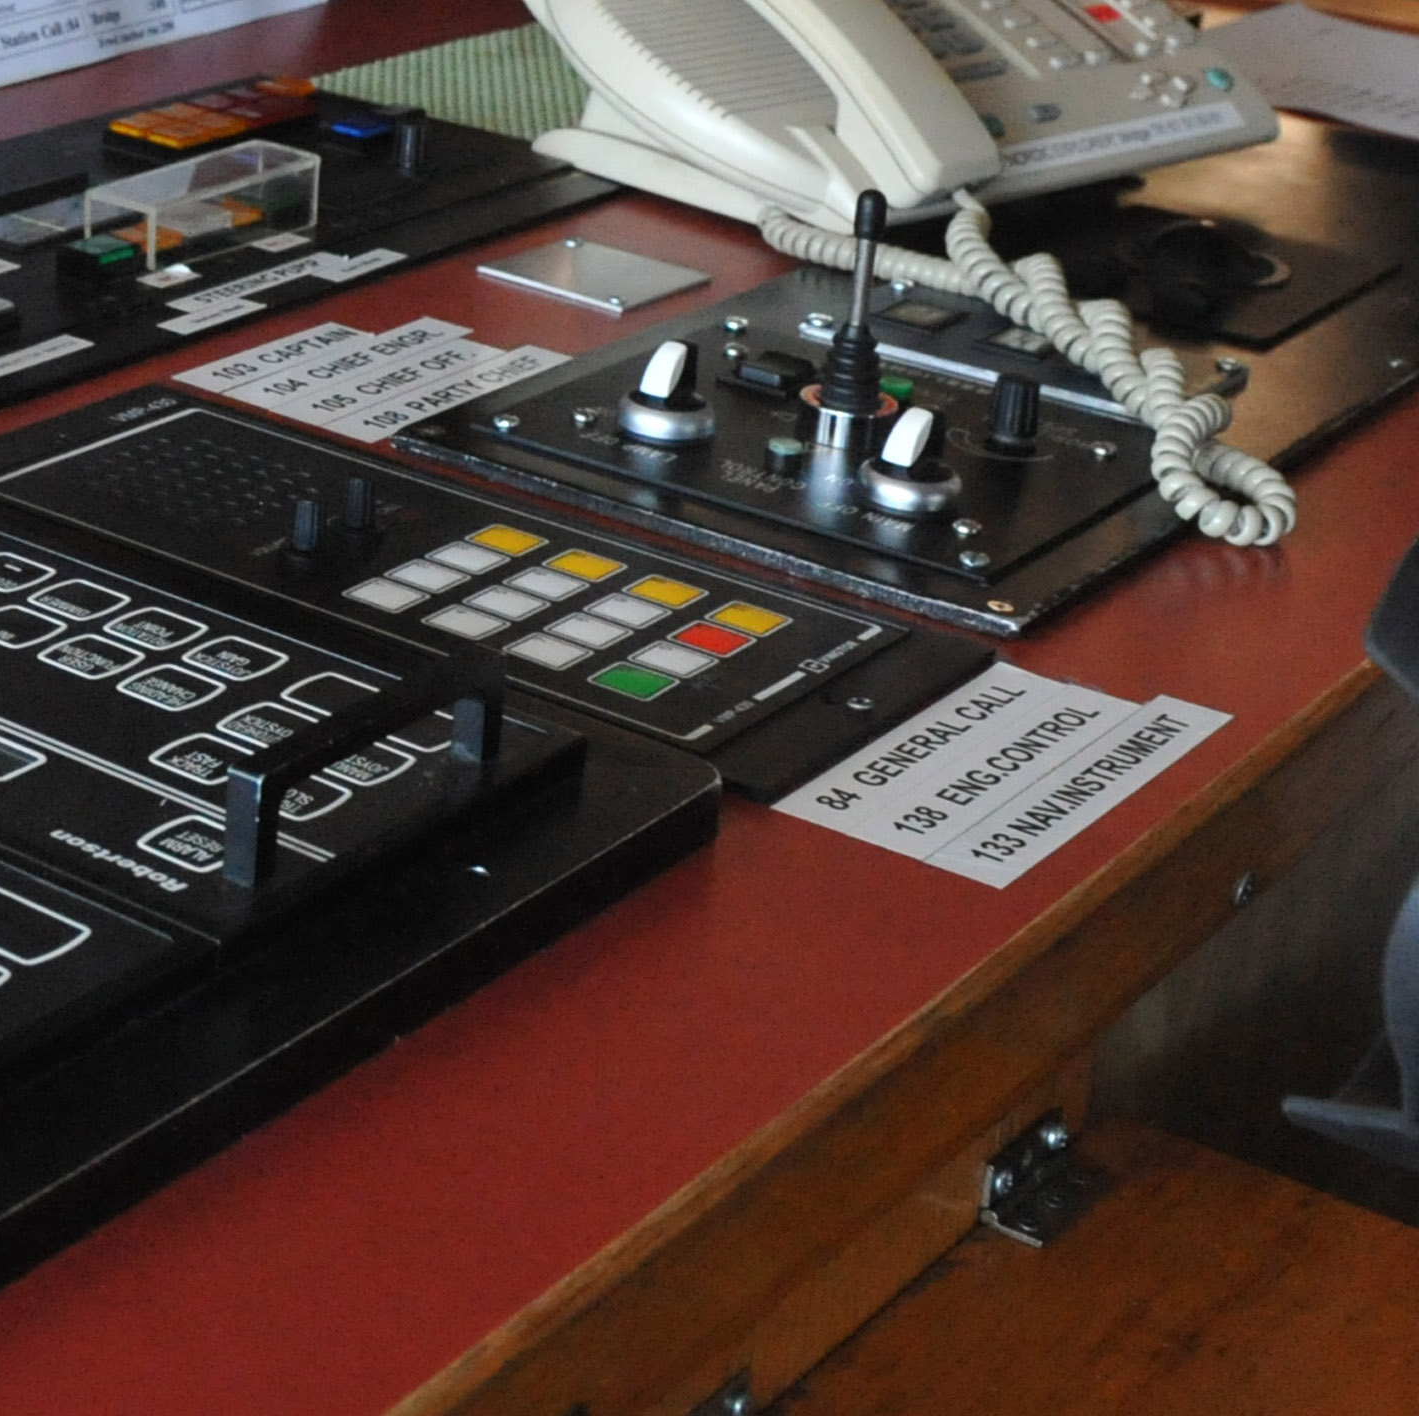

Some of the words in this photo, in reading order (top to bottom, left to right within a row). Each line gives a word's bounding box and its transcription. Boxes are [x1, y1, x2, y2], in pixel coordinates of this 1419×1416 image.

[211, 361, 259, 382] 103
[258, 327, 360, 366] CAPTAIN
[263, 376, 310, 397] 104
[307, 352, 374, 381] CHIEF
[311, 393, 358, 414] 105
[356, 365, 425, 397] CHIEF
[362, 408, 411, 432] 108
[404, 376, 481, 414] PARTY
[476, 353, 544, 386] CHIEF
[186, 749, 225, 770] FAST
[816, 786, 860, 812] 84
[852, 719, 972, 788] GENERAL
[955, 684, 1028, 722] CALL
[893, 805, 950, 836] 138
[935, 705, 1101, 807] ENG.CONTROL
[971, 833, 1028, 864] 133
[1007, 713, 1191, 839] NAV.INSTRUMENT
[48, 828, 189, 893] Robertson
